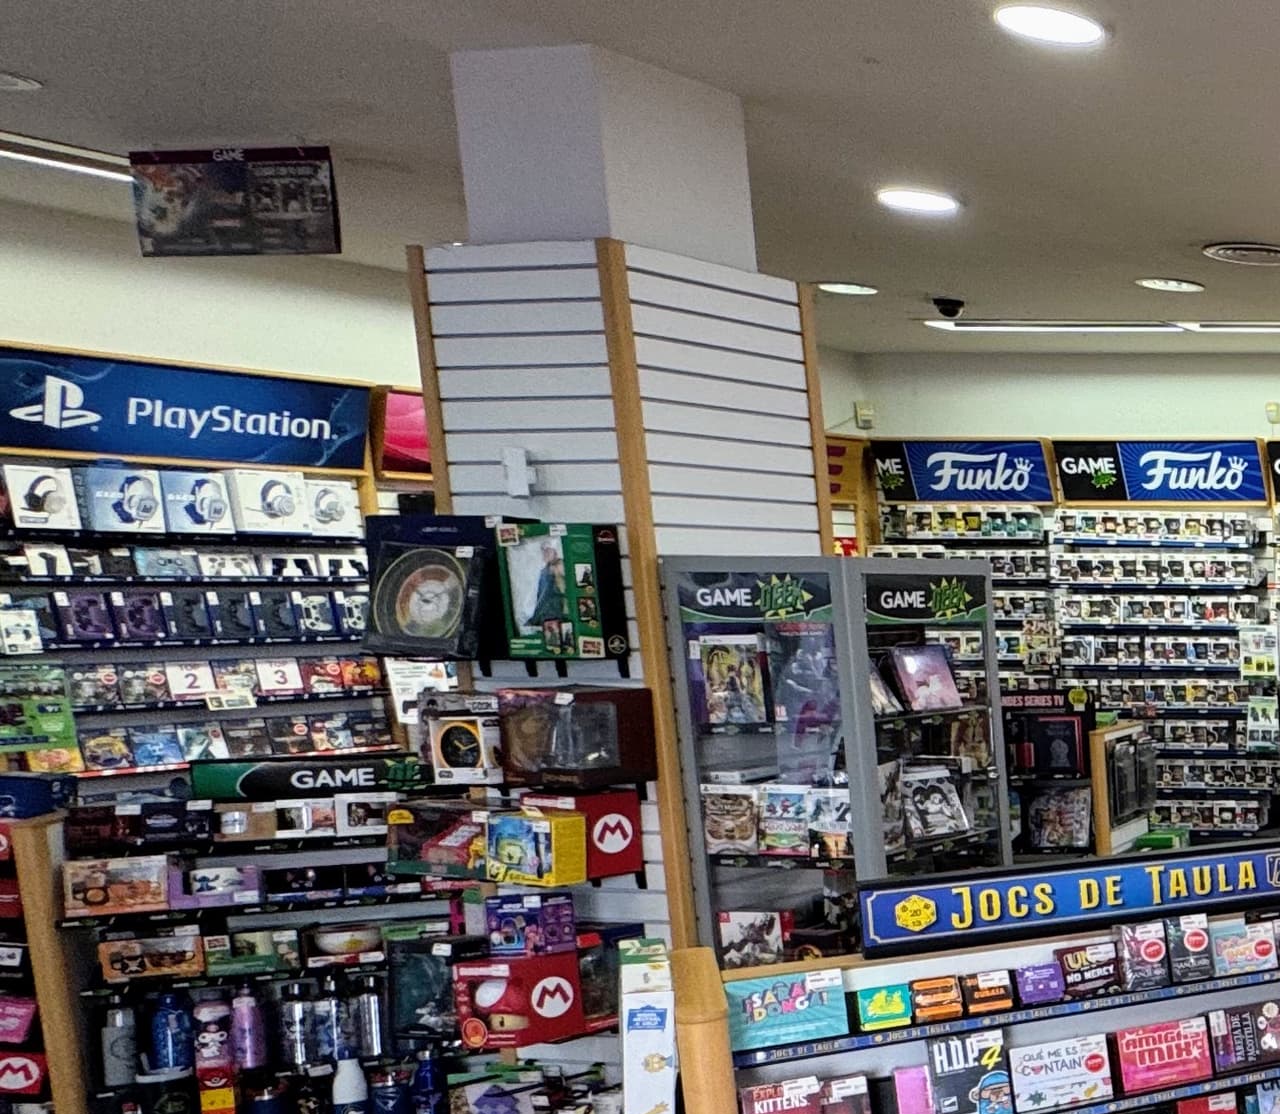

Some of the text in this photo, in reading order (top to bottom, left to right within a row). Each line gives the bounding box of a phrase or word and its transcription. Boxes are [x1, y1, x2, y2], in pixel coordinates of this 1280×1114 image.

[212, 148, 244, 162] GAME
[127, 397, 326, 440] PlayStation
[927, 451, 1034, 491] Funko
[1062, 457, 1116, 476] GAME
[1139, 450, 1248, 491] Funko
[696, 587, 752, 607] GAME
[881, 590, 926, 610] GAME
[184, 671, 198, 689] 2
[274, 670, 288, 687] 3
[290, 768, 376, 789] GAME
[951, 860, 1257, 930] JOCS DE TAULA
[1066, 971, 1082, 984] NO
[1084, 965, 1114, 981] MERCY
[1243, 1012, 1257, 1061] PACOTILLA
[981, 1044, 1002, 1070] 4
[1048, 1048, 1063, 1060] ME
[1136, 1041, 1194, 1067] MIX
